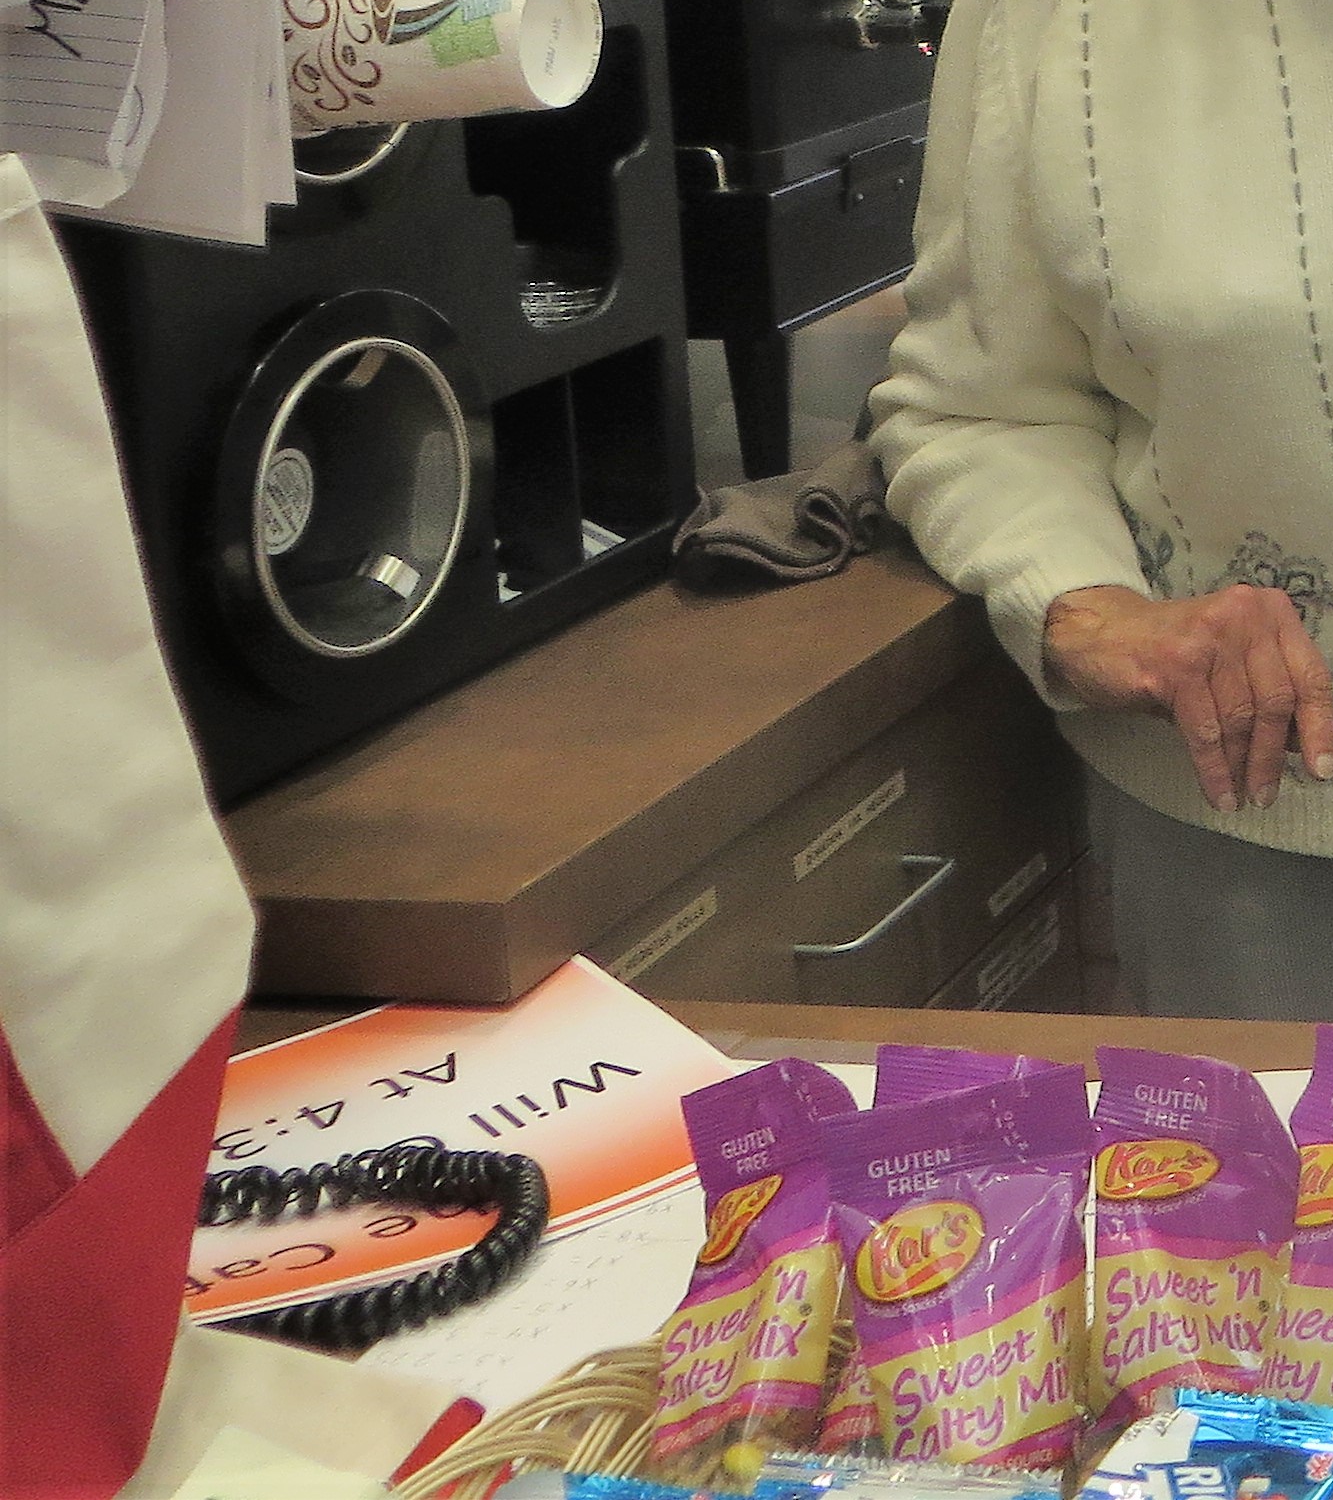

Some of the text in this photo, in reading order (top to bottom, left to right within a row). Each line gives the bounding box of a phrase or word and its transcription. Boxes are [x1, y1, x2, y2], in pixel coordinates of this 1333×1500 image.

[213, 1051, 456, 1160] At 4:3
[468, 1060, 642, 1139] Will
[1134, 1083, 1209, 1113] GLUTEN
[1144, 1108, 1194, 1131] FREE
[721, 1126, 777, 1160] GLUTEN
[736, 1150, 773, 1176] FREE
[867, 1148, 952, 1179] GLUTEN
[1104, 1143, 1210, 1189] Kar's
[887, 1170, 942, 1198] FREE
[869, 1209, 970, 1292] Kar's
[1106, 1261, 1262, 1325] Sweet 'n
[1102, 1311, 1268, 1387] Salty Mix
[892, 1328, 1037, 1426] Sweet
[1018, 1356, 1071, 1413] Mi
